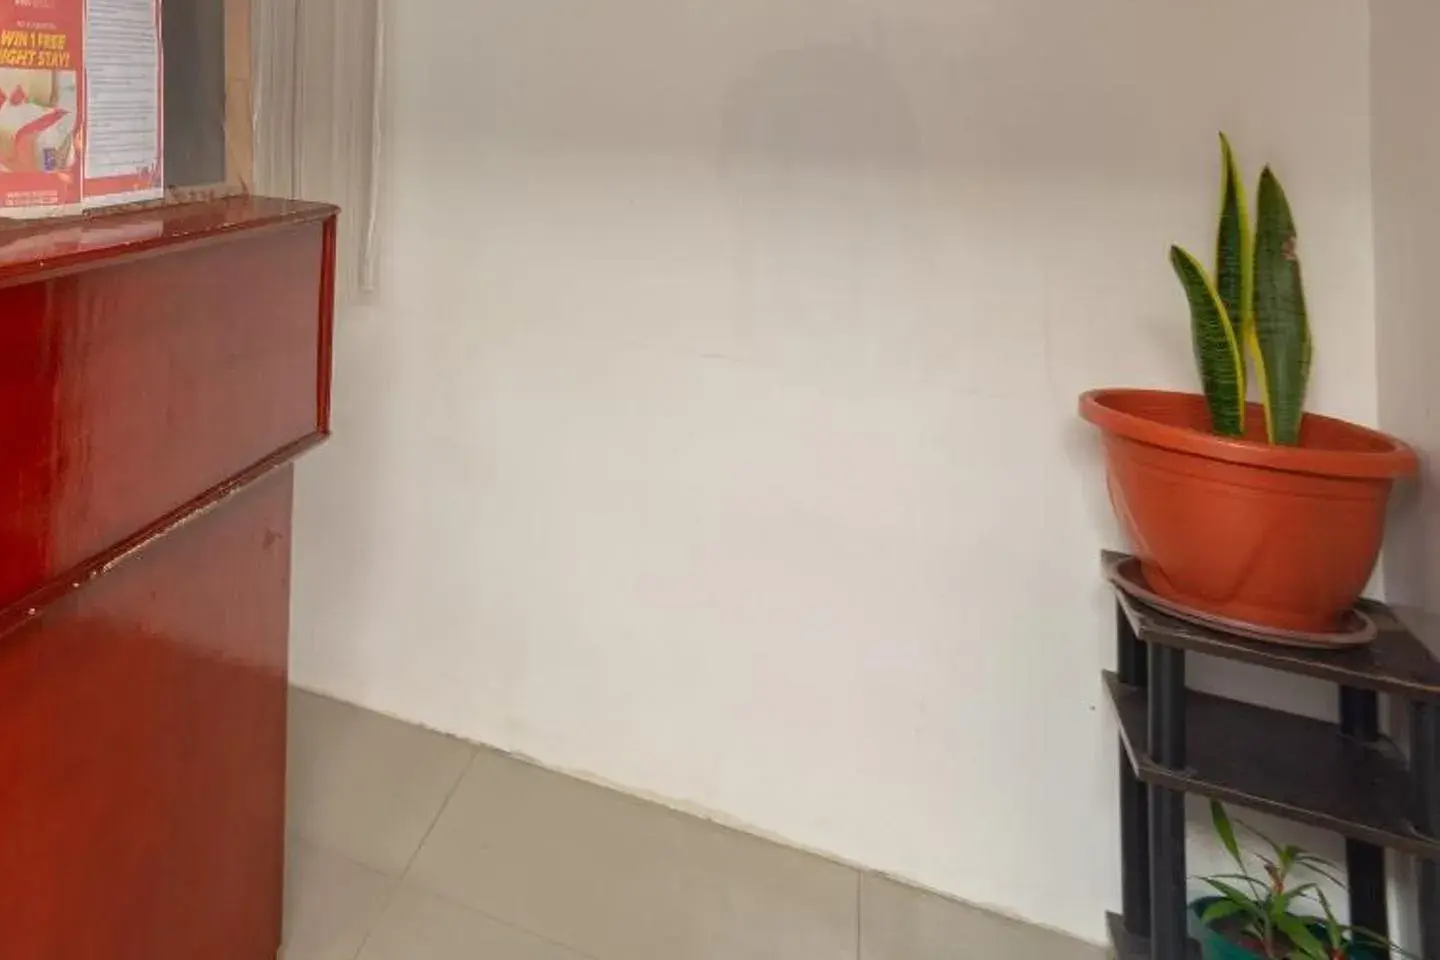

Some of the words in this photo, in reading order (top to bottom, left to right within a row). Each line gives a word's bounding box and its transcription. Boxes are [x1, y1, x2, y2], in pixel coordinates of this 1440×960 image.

[0, 29, 28, 48] WIN
[29, 31, 37, 49] 1
[37, 33, 66, 50] FREE
